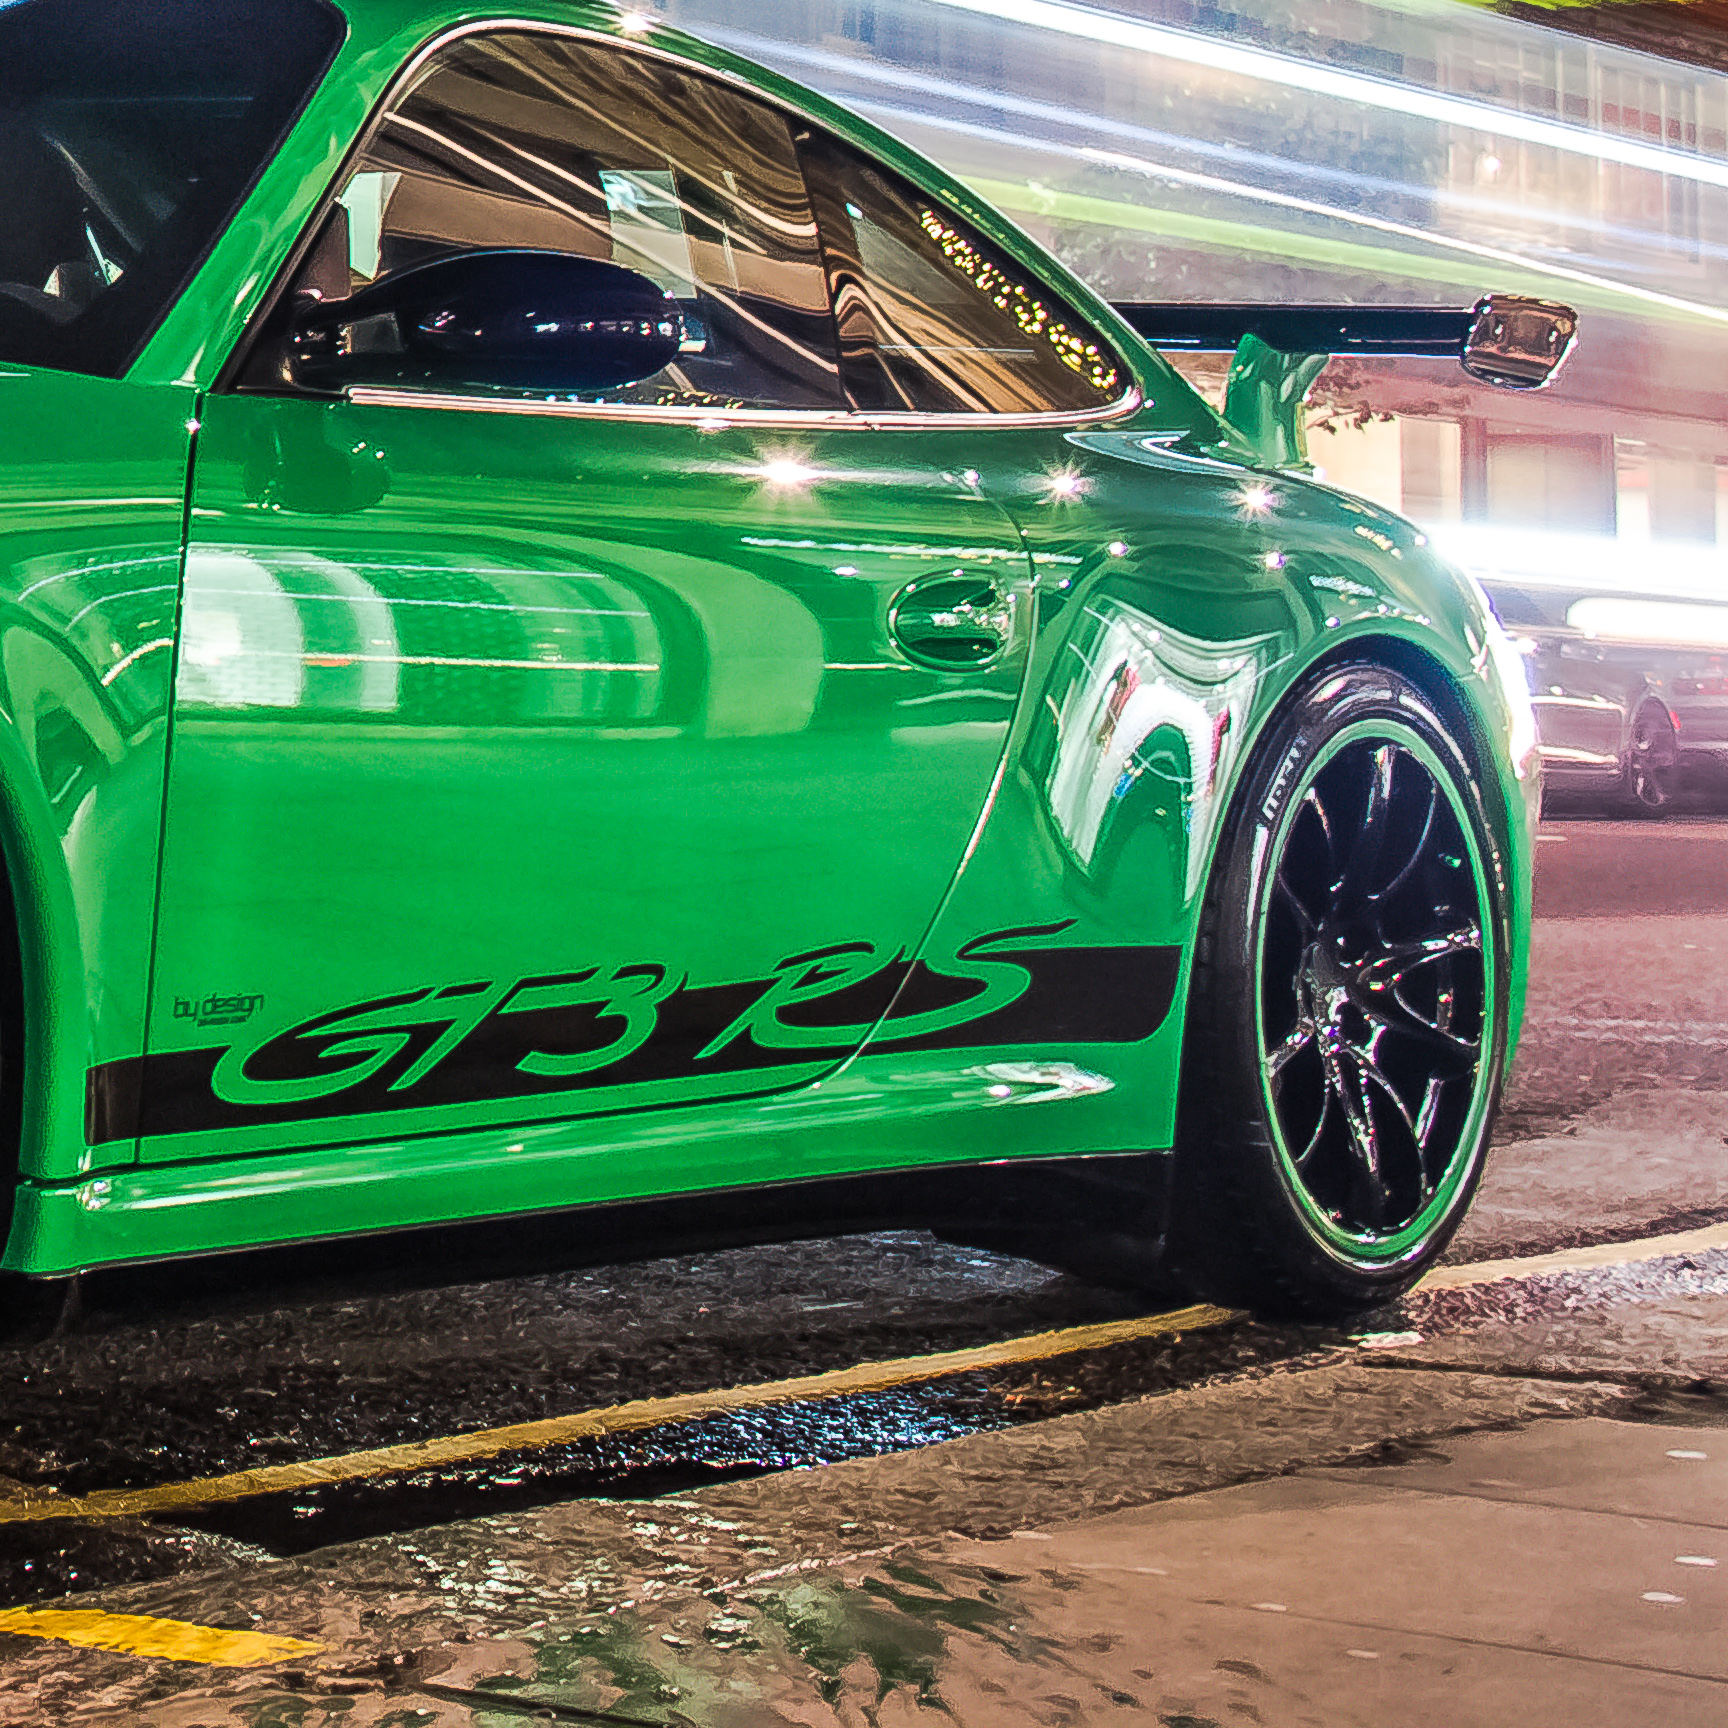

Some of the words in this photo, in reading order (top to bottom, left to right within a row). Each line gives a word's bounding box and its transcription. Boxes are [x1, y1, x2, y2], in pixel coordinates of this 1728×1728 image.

[173, 995, 199, 1022] by
[202, 992, 264, 1019] design
[211, 962, 688, 1105] GT3
[694, 917, 1078, 1060] RS
